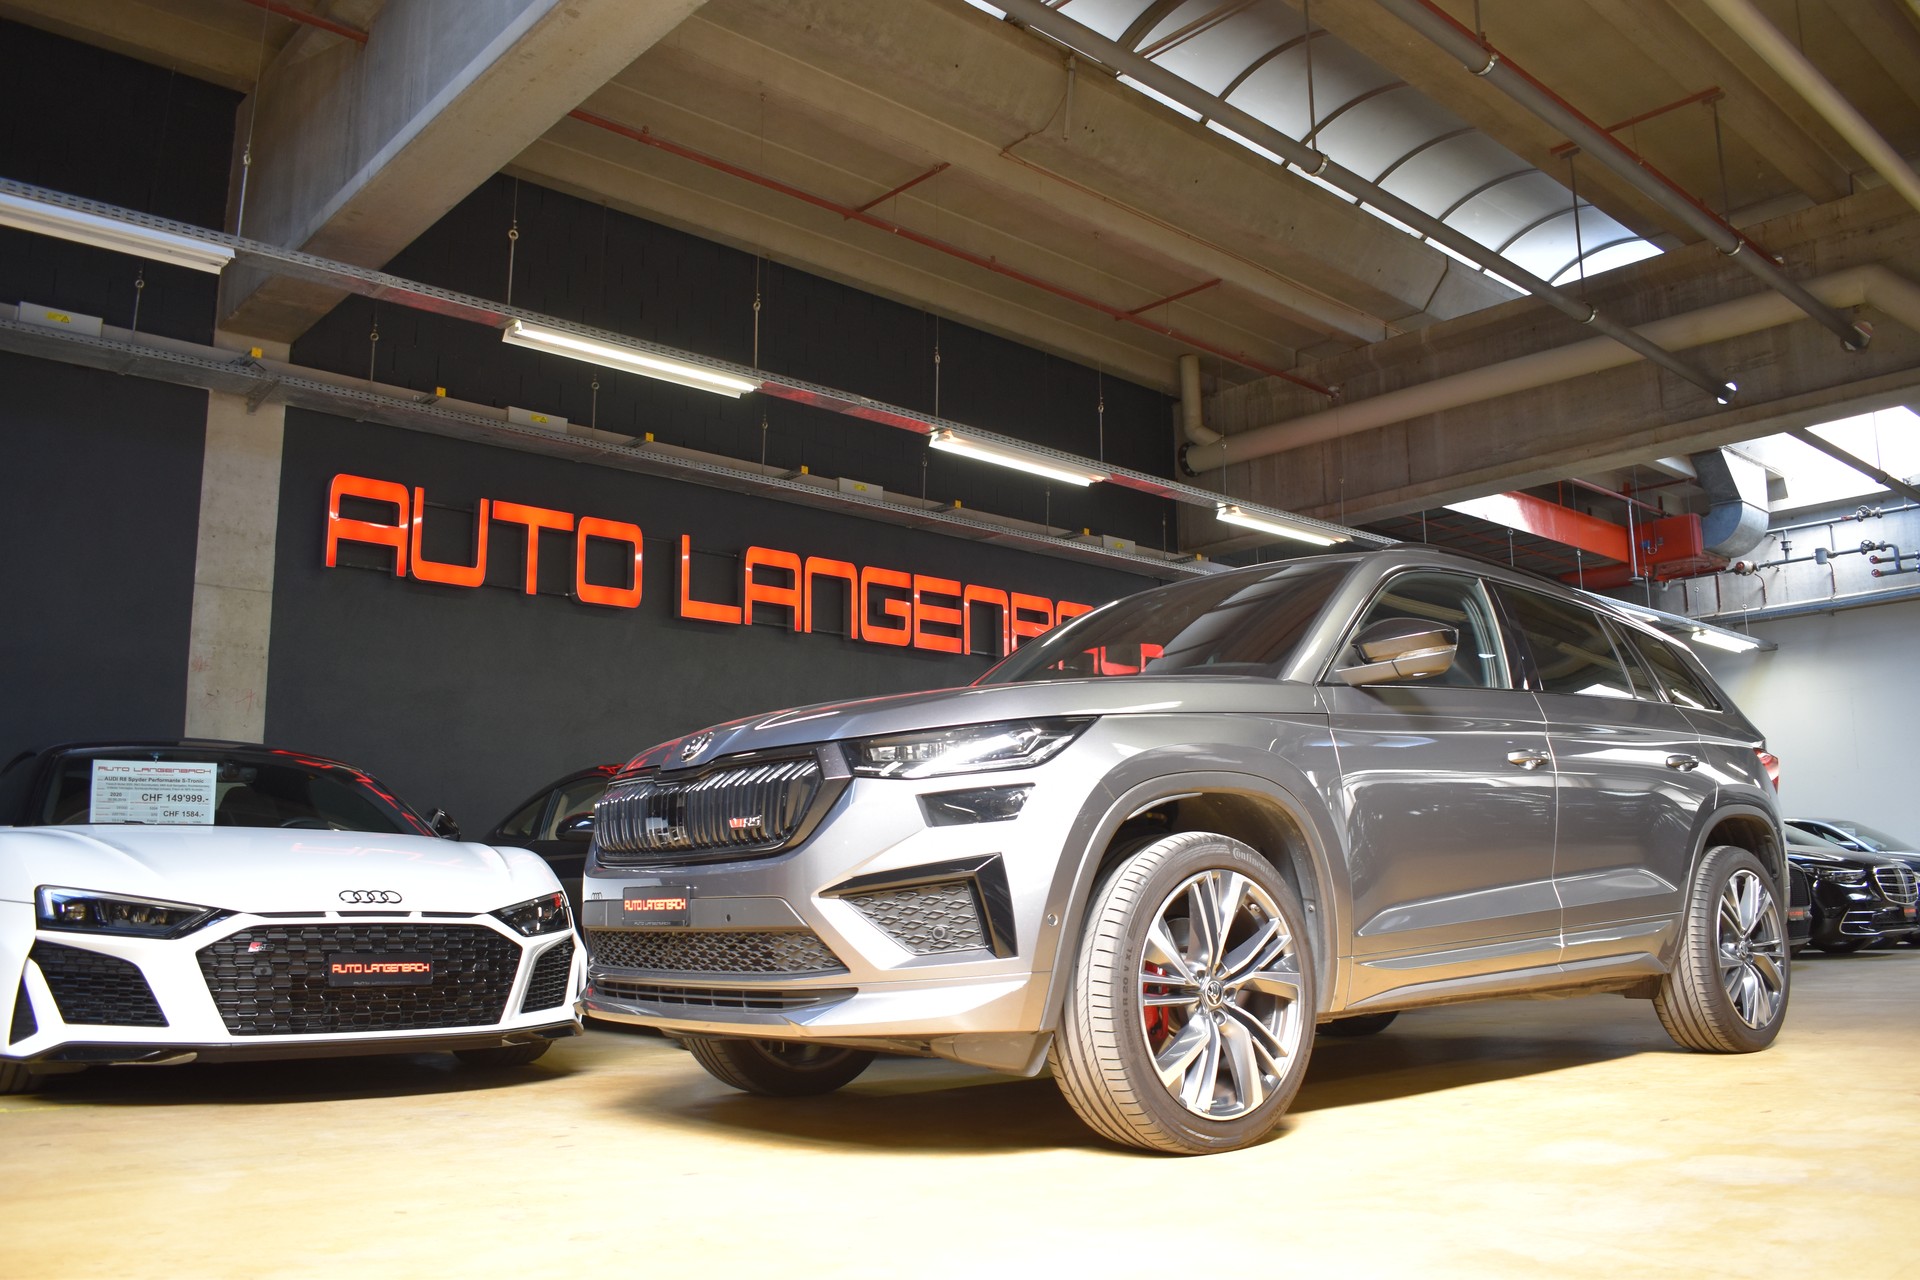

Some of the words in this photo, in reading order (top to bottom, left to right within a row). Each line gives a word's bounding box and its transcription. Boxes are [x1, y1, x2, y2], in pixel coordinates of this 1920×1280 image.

[325, 473, 643, 609] AUTO
[141, 793, 163, 802] CHF
[166, 794, 209, 803] 149'999.-
[163, 810, 179, 818] CHF
[624, 899, 642, 911] AUTO
[642, 898, 687, 911] LANGENBACH
[331, 963, 362, 974] AUTO
[363, 962, 430, 974] LANGENBACH
